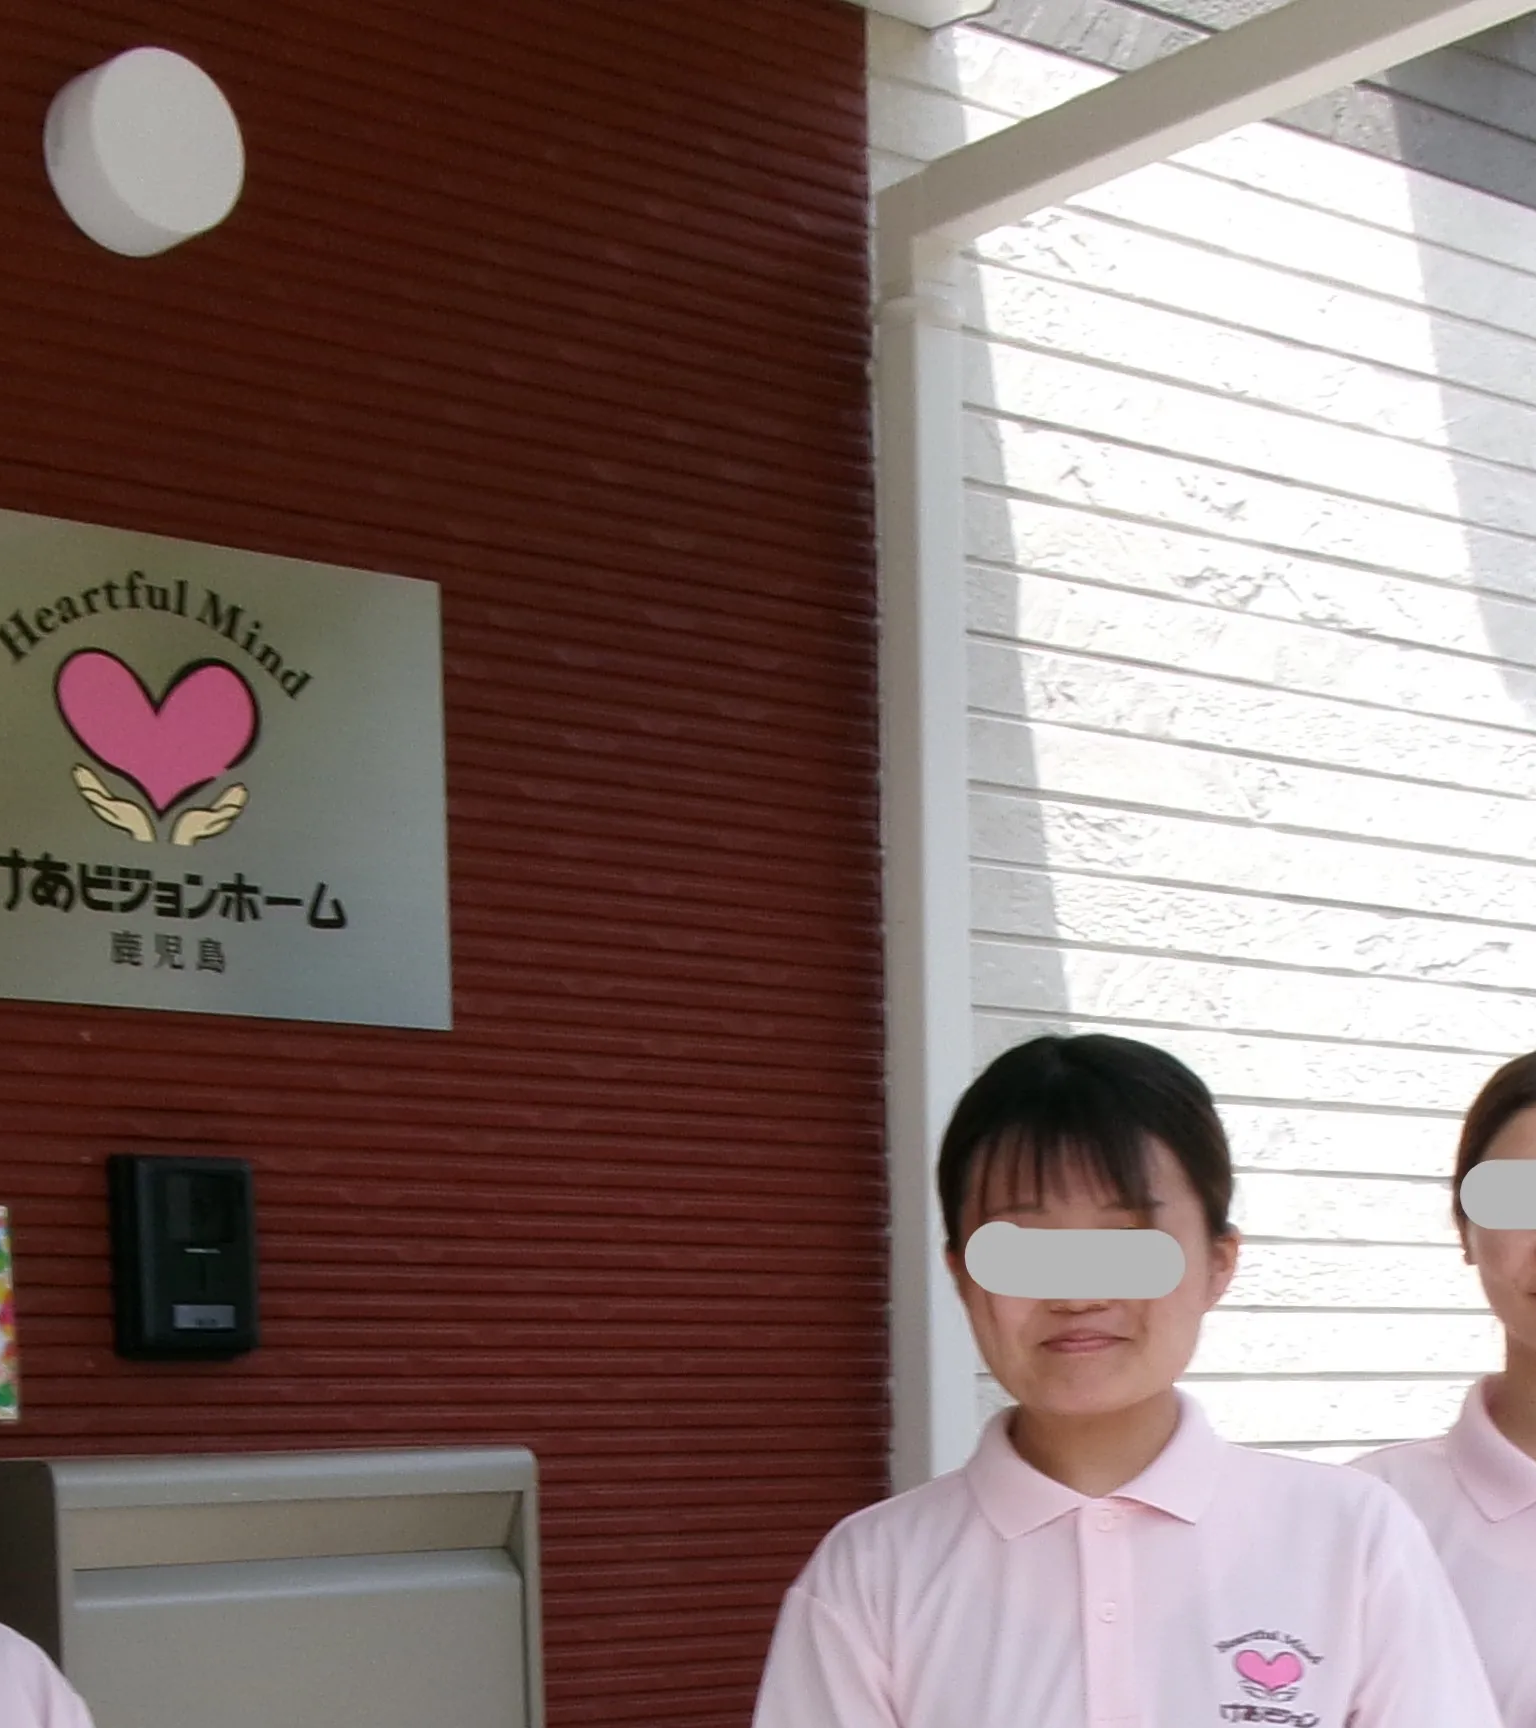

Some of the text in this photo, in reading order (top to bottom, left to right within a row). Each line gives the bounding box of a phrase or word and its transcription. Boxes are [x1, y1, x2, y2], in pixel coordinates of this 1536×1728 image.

[195, 587, 314, 701] Mind
[109, 931, 227, 974] 鹿児島
